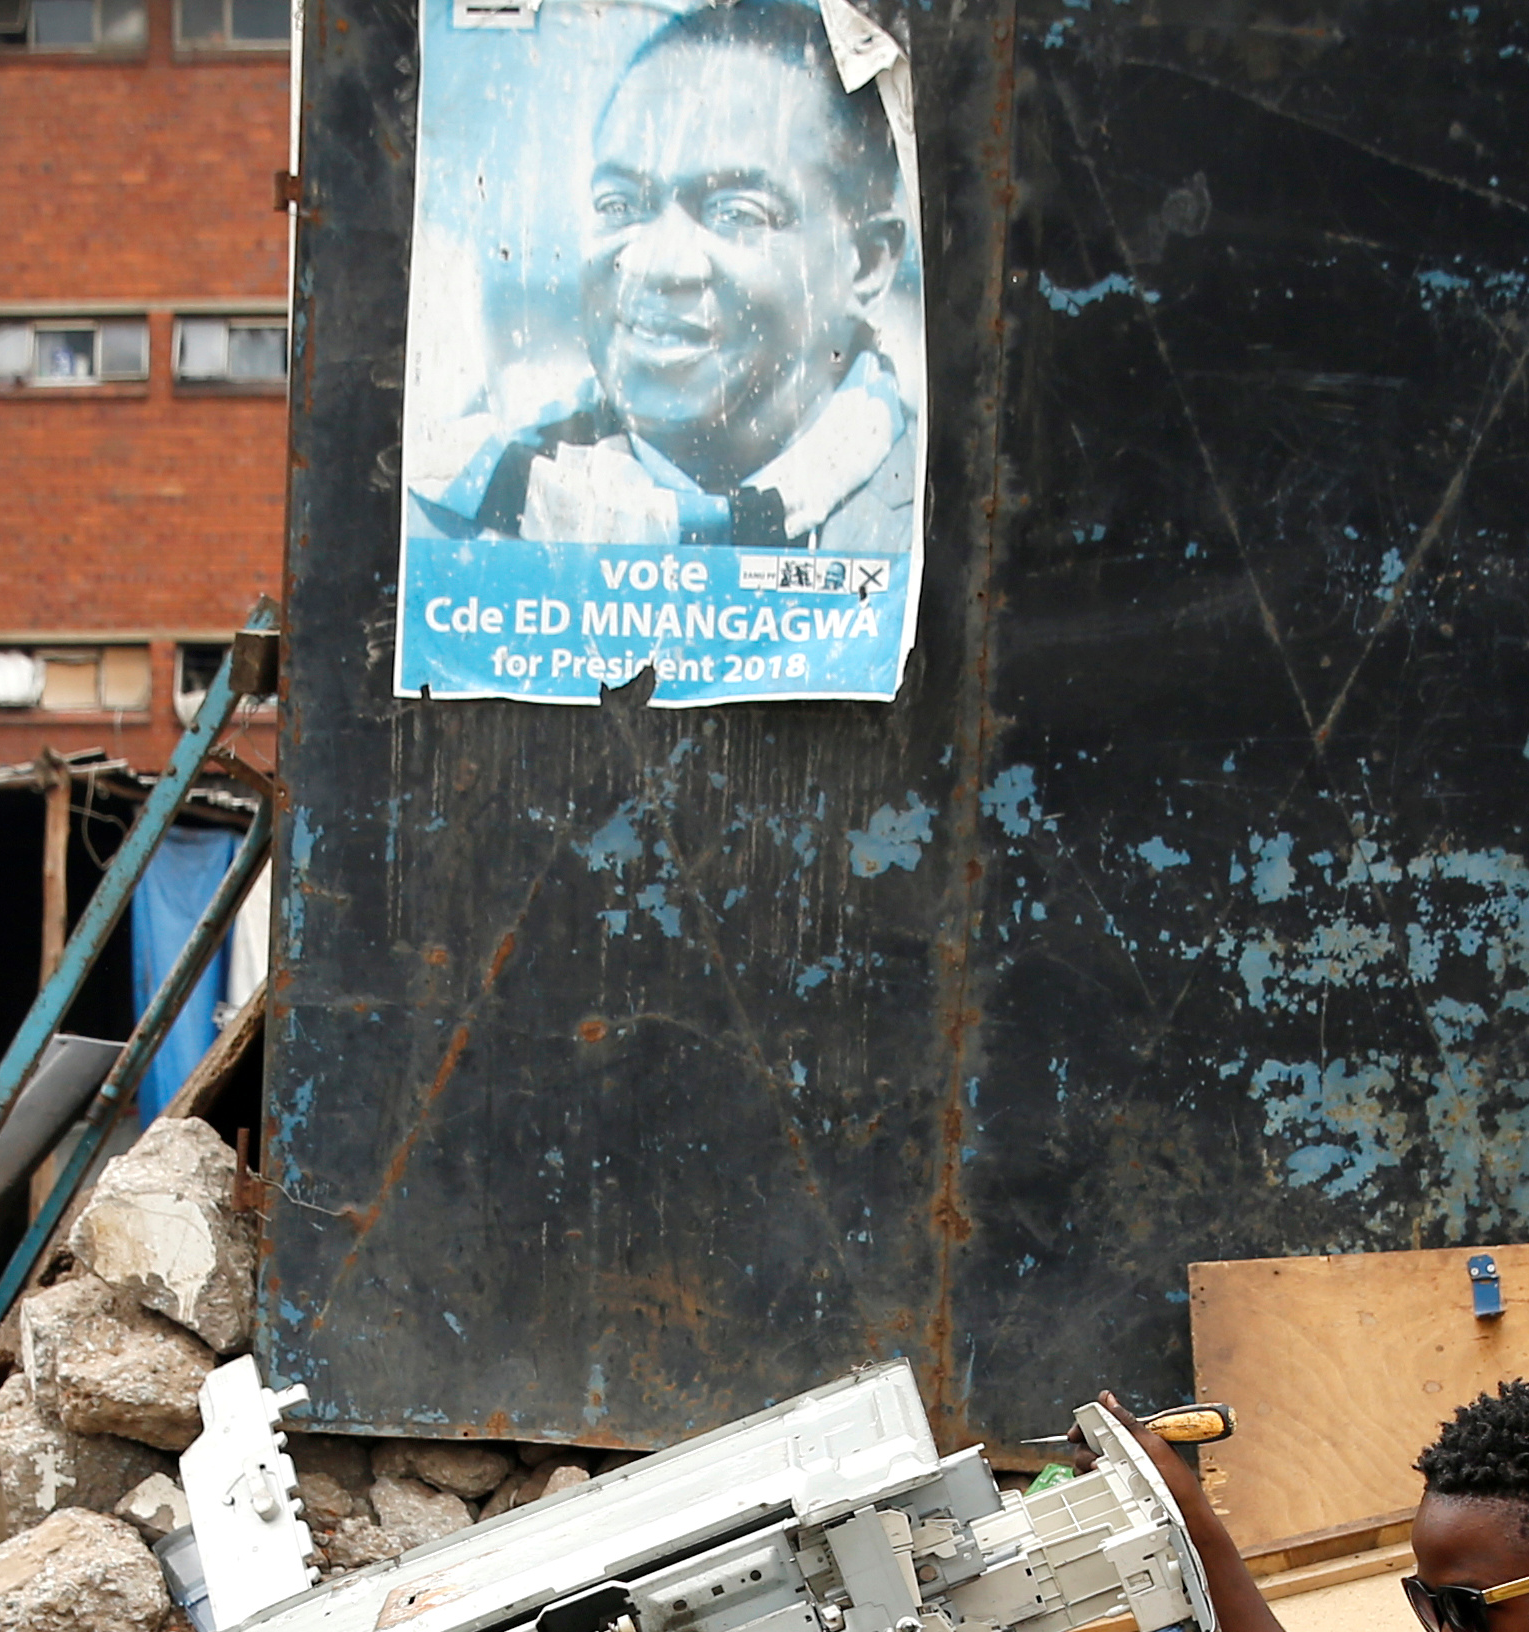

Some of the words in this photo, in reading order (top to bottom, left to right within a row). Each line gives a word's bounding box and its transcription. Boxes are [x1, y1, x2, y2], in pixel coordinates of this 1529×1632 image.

[599, 554, 708, 592] vote
[425, 597, 504, 634] Cde
[514, 598, 571, 635] ED
[581, 601, 879, 642] MNANGAGWA
[491, 645, 542, 677] for
[722, 653, 806, 683] 2018
